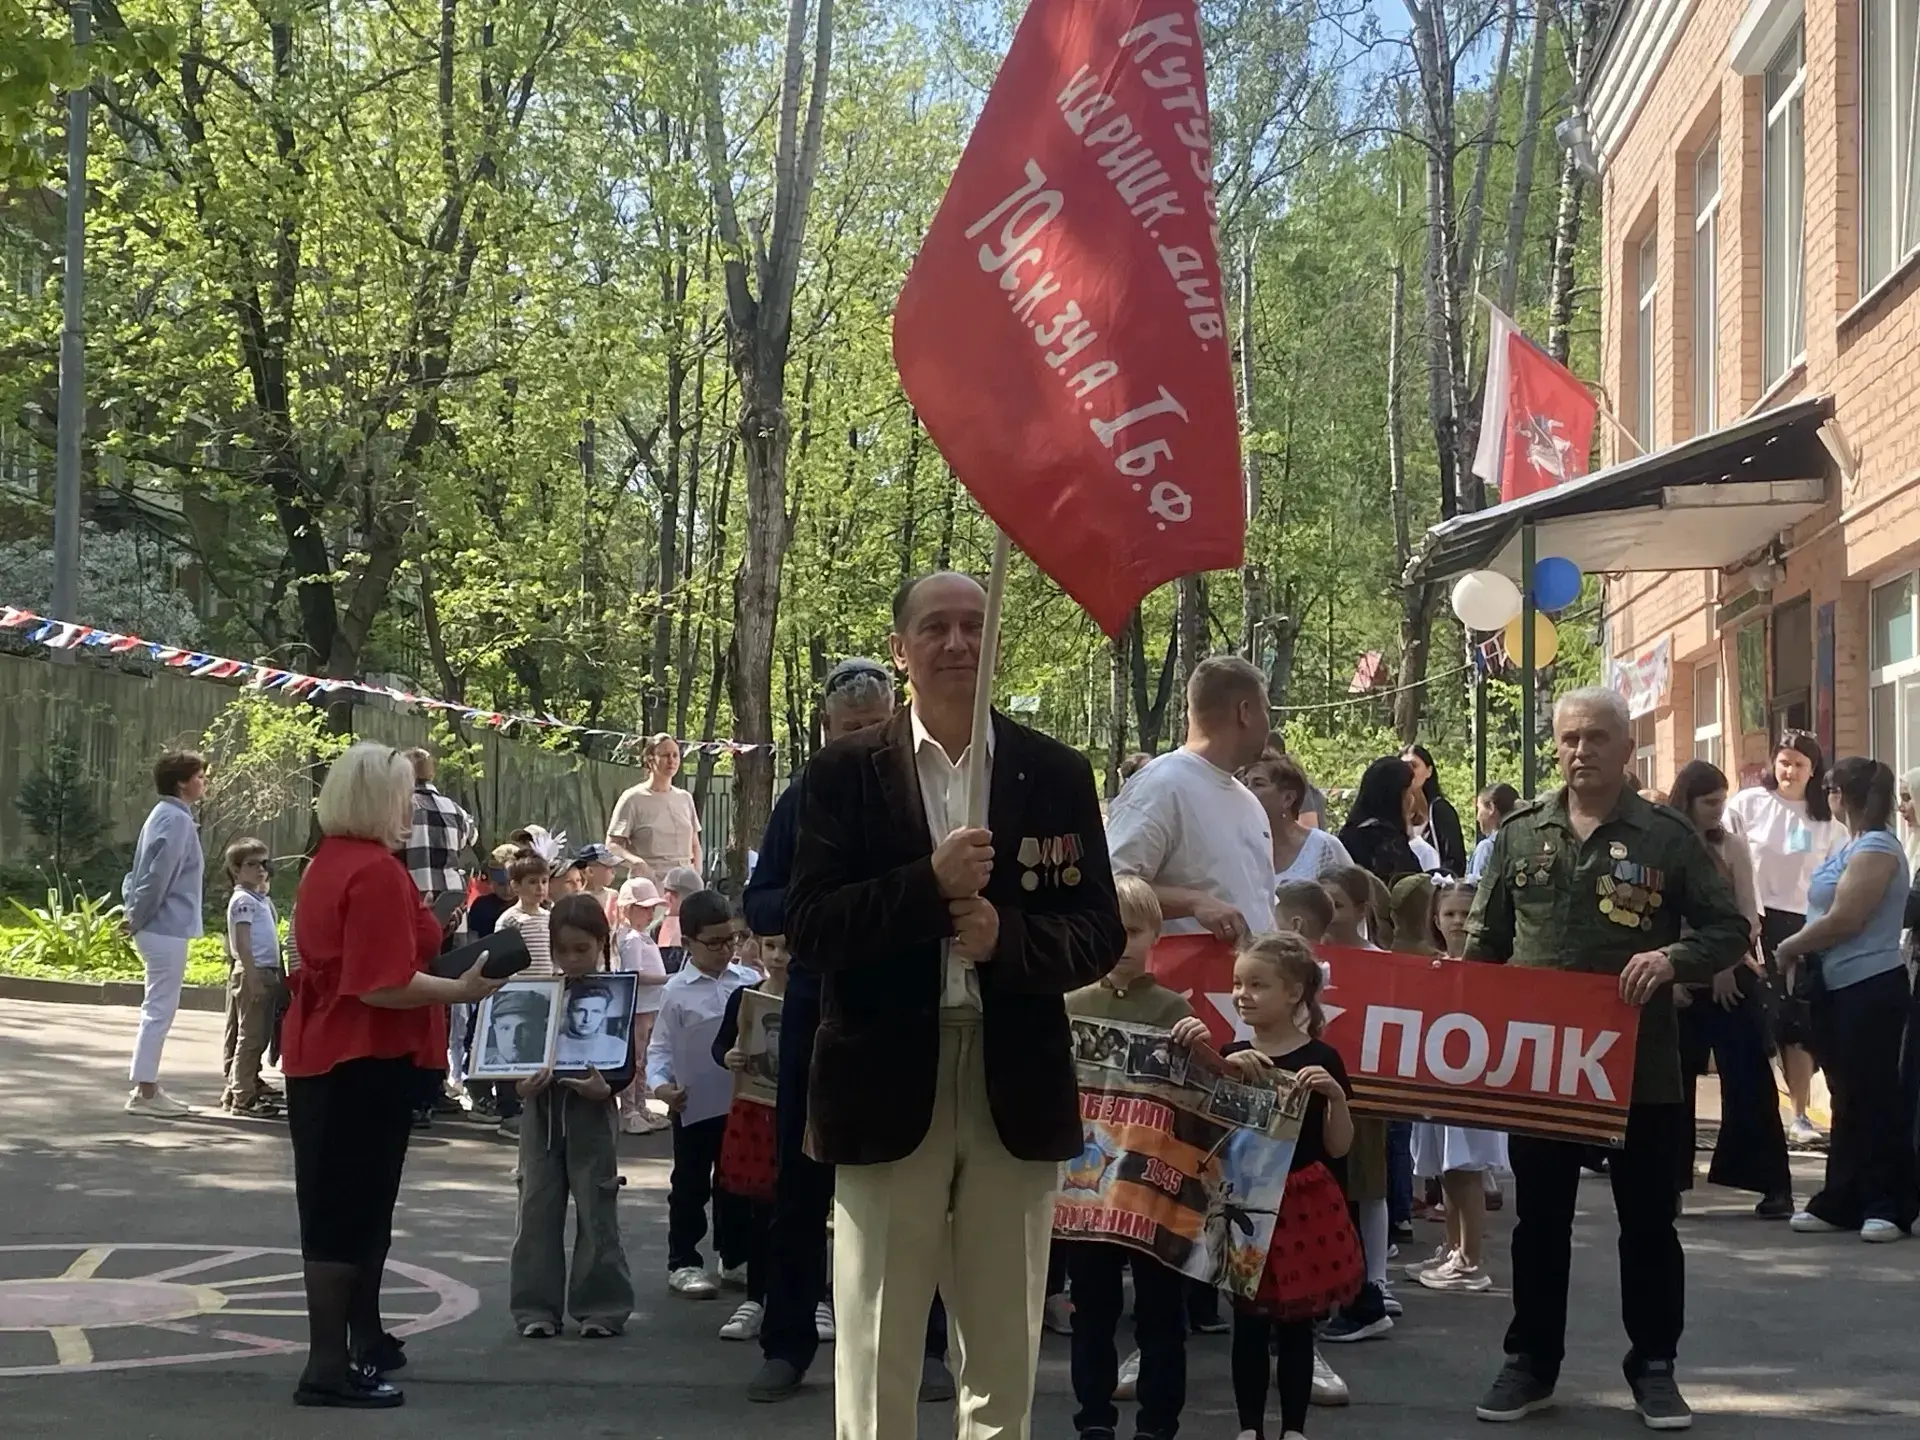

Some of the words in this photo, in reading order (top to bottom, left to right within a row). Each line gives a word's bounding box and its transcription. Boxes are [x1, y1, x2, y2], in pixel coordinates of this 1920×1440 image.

[1360, 1004, 1621, 1101] ПОЛК
[1079, 1092, 1176, 1141] БЕДИЛИ,
[1141, 1158, 1184, 1195] 1945
